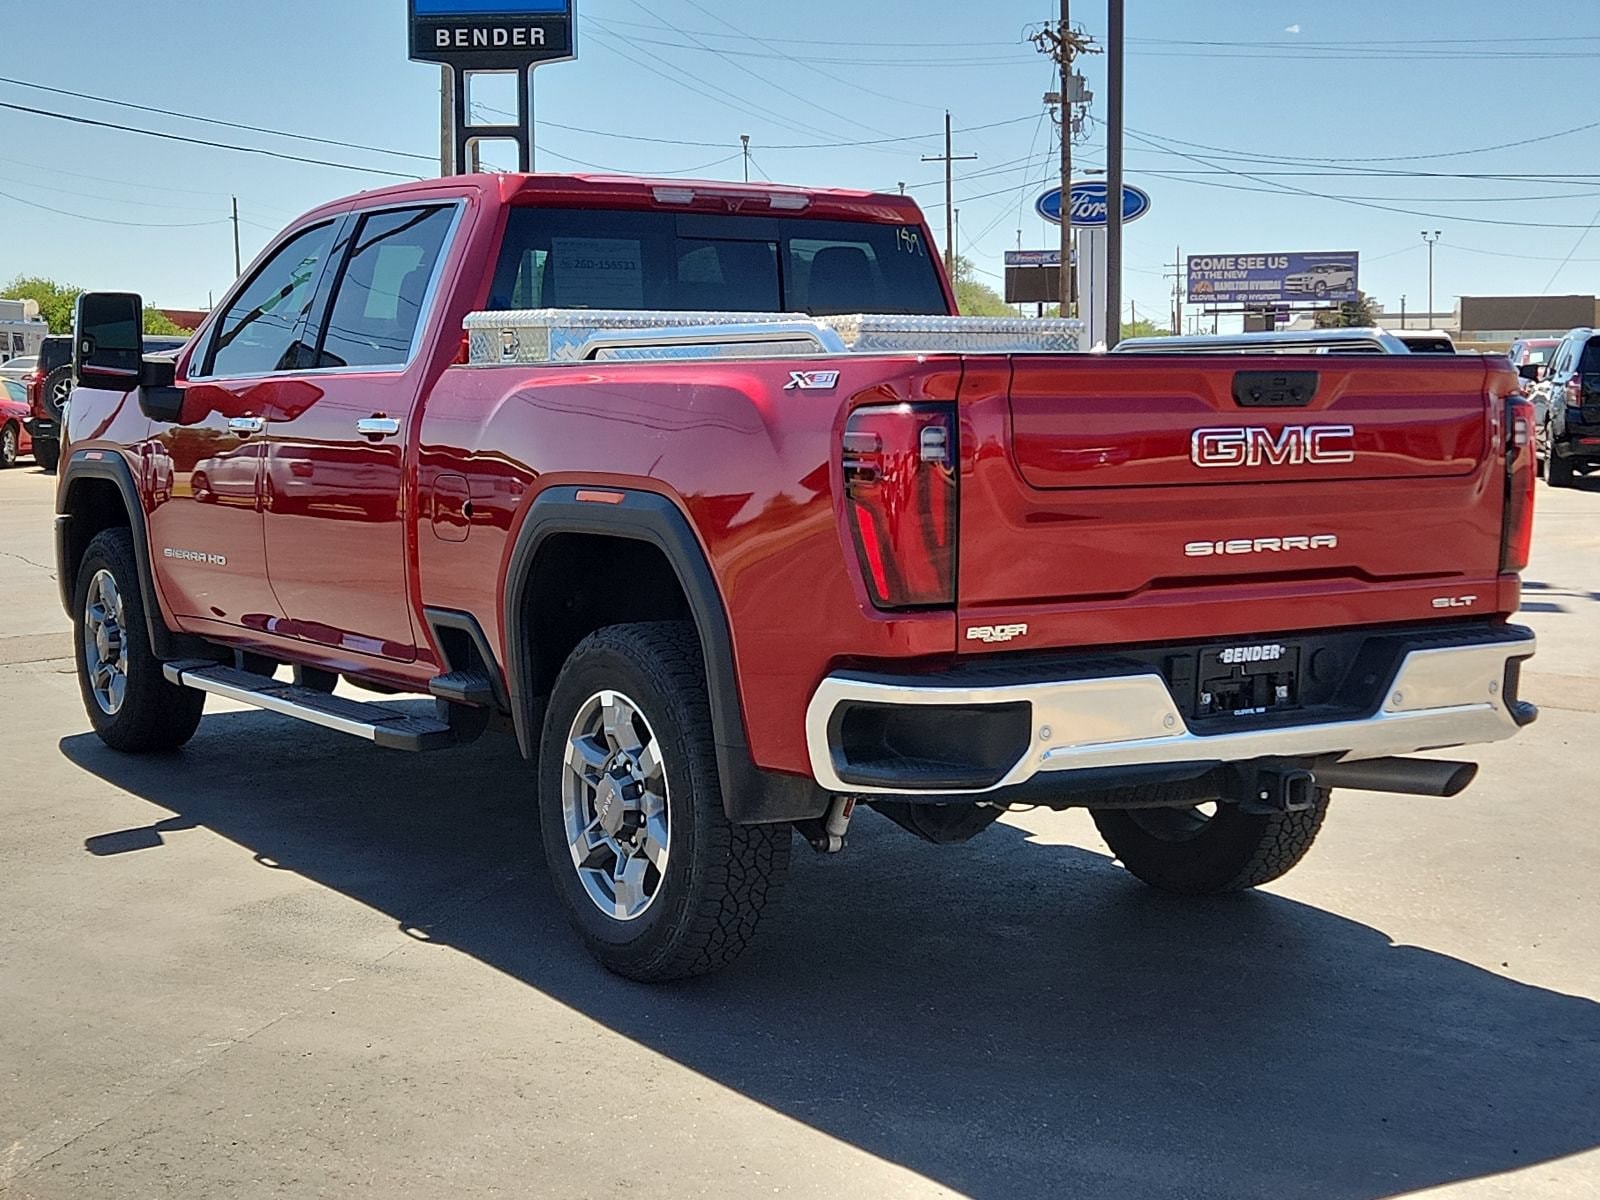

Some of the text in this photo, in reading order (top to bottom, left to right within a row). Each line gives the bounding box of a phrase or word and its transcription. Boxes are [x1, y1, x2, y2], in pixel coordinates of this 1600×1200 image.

[436, 28, 545, 47] BENDER
[896, 227, 923, 256] 189
[1190, 256, 1289, 270] COME SEE US
[1190, 270, 1249, 280] AT THE NEW
[1191, 425, 1354, 467] GMC
[1184, 535, 1338, 556] SIERRA
[164, 548, 227, 565] SIERRA HD
[1432, 595, 1478, 608] SLT
[966, 623, 1028, 639] BENDER
[1223, 644, 1281, 663] BENDER
